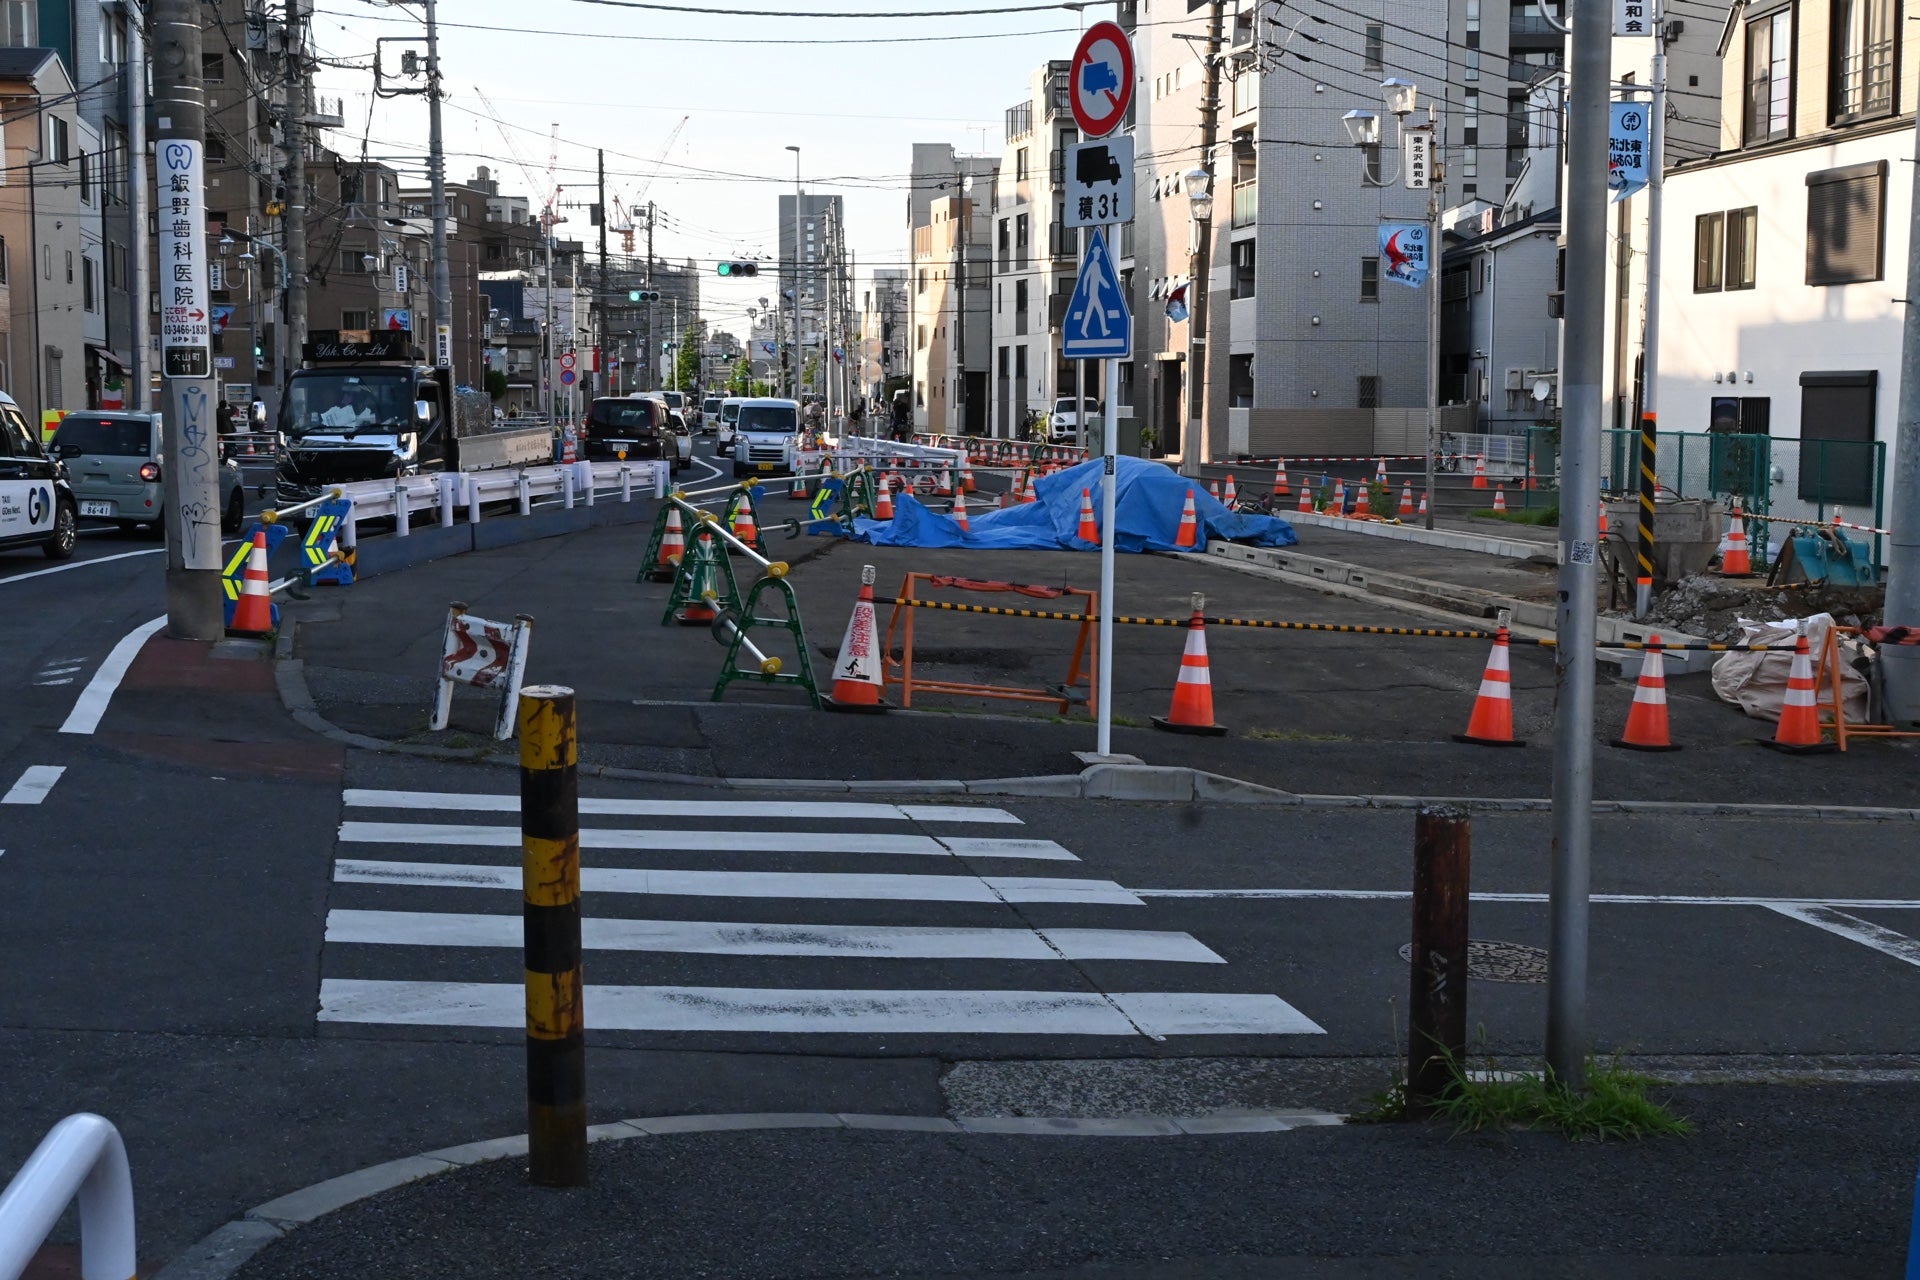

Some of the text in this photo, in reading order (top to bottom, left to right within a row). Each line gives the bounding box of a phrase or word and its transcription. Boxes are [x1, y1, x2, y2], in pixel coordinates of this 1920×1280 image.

[1413, 136, 1423, 186] 東北沢商和会
[1079, 193, 1118, 220] 積3t
[171, 174, 194, 305] 飯野歯科医院
[173, 353, 200, 361] 大山町
[182, 364, 191, 372] 11
[29, 486, 50, 525] GO
